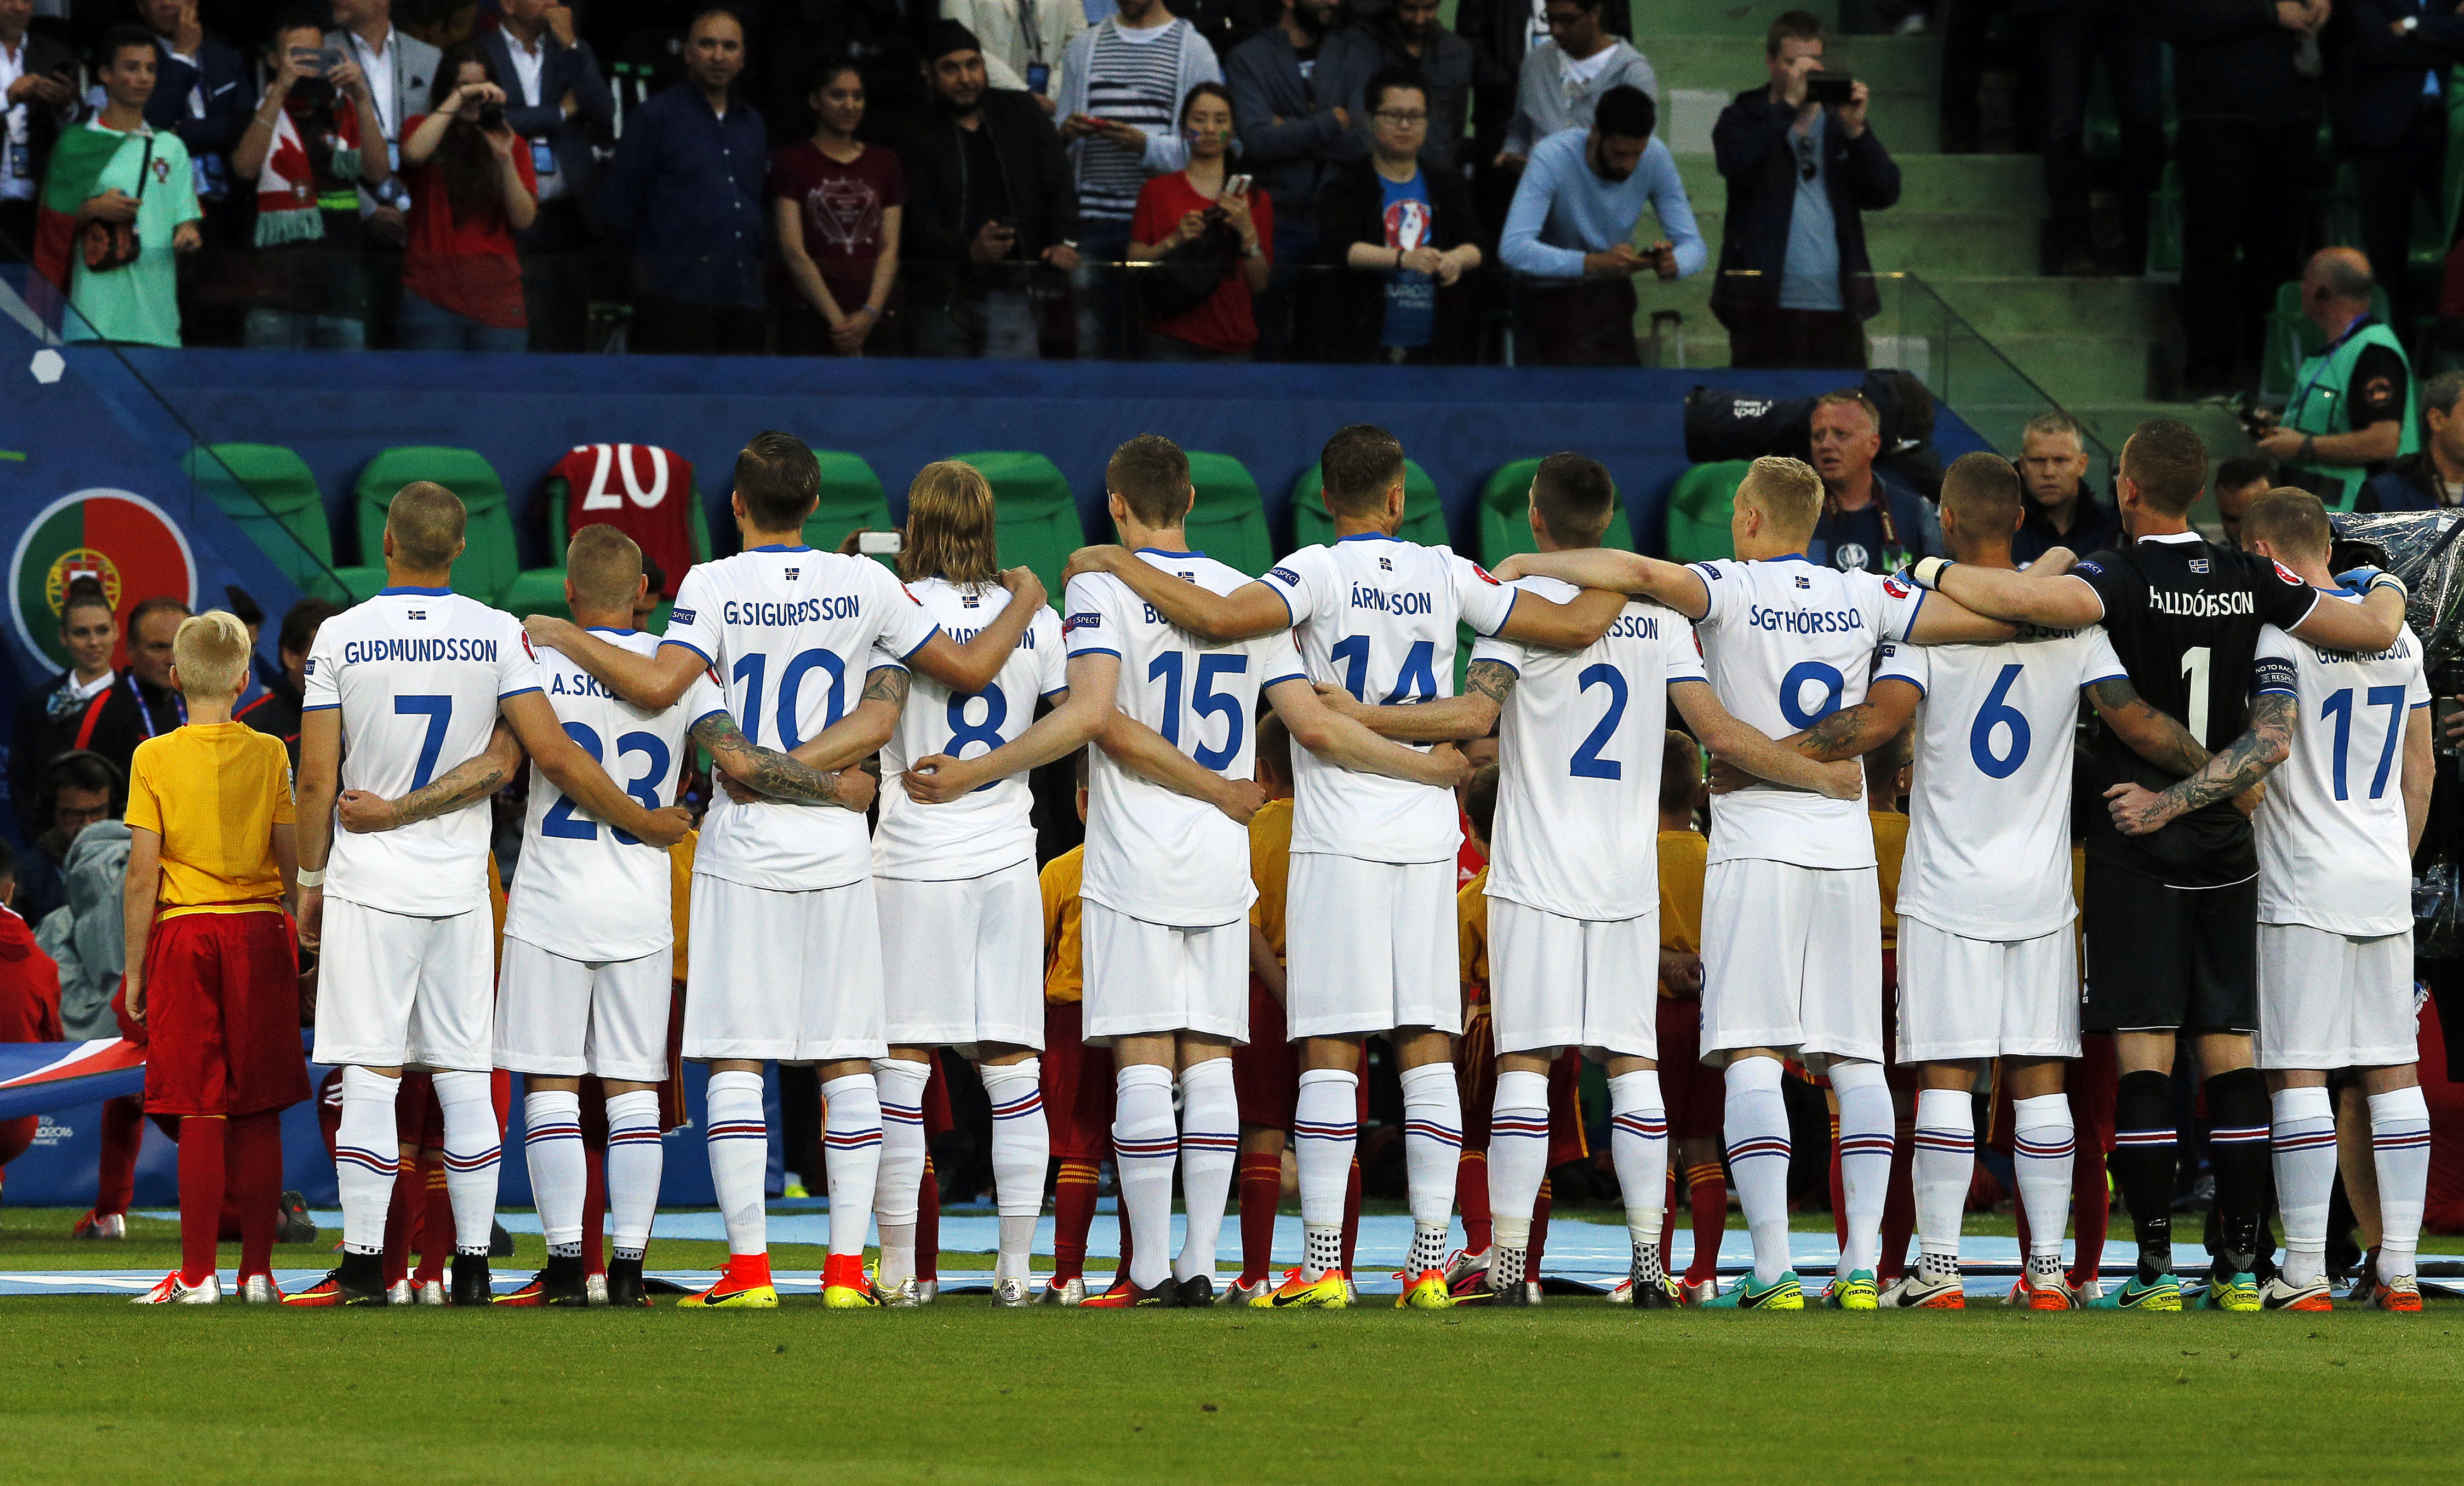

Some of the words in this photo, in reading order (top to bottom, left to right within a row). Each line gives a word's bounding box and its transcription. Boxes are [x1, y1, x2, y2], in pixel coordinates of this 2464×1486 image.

[573, 443, 669, 511] 20
[345, 638, 497, 664] GUÐMUNDSSON
[670, 611, 695, 621] SPECT
[395, 695, 453, 792] 7
[733, 648, 845, 752] 10
[942, 682, 1008, 791] 8
[1148, 650, 1248, 770] 15
[1330, 635, 1437, 746] 14
[1569, 664, 1628, 780] 2
[1779, 661, 1844, 729] 9
[1970, 664, 2031, 779] 6
[2181, 647, 2211, 748] 1
[2320, 685, 2405, 801] 17
[542, 721, 671, 845] 23
